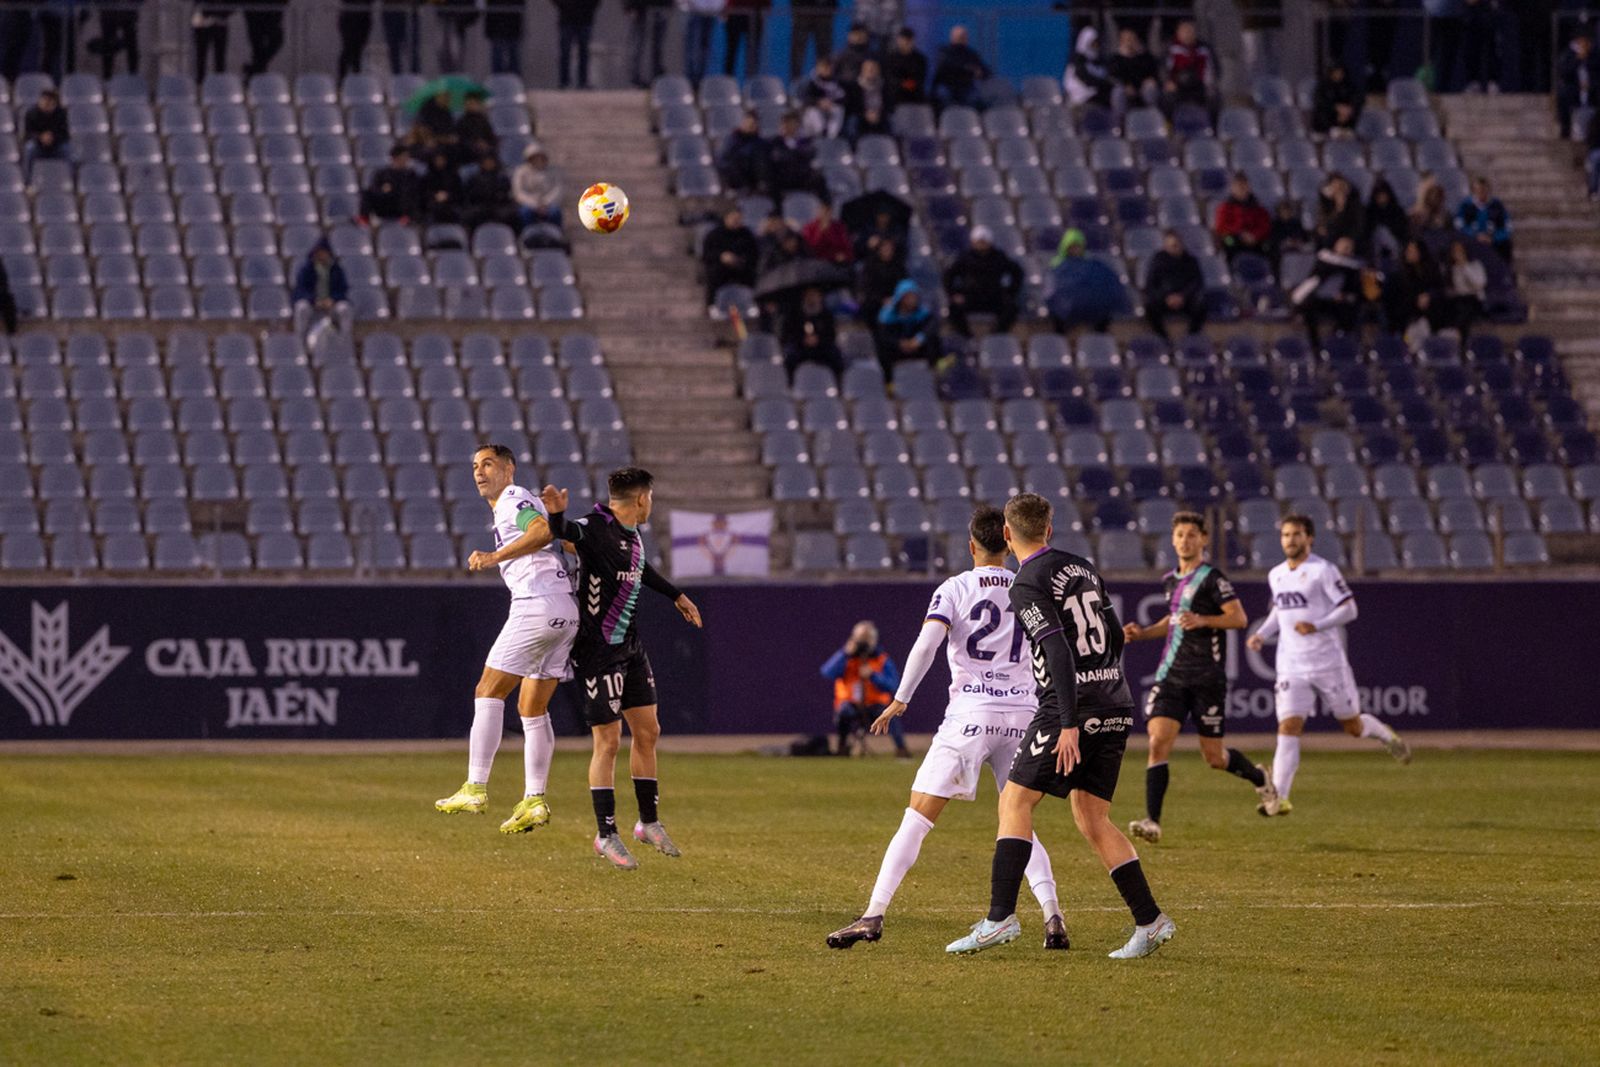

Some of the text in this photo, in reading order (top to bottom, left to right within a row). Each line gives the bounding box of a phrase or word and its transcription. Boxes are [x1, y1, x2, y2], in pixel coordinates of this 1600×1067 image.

[979, 575, 1014, 588] MOH
[966, 599, 1023, 663] 21
[1063, 590, 1106, 657] 15
[145, 638, 420, 678] CAJA RURAL
[225, 681, 340, 728] JAÉN
[603, 672, 624, 698] 10
